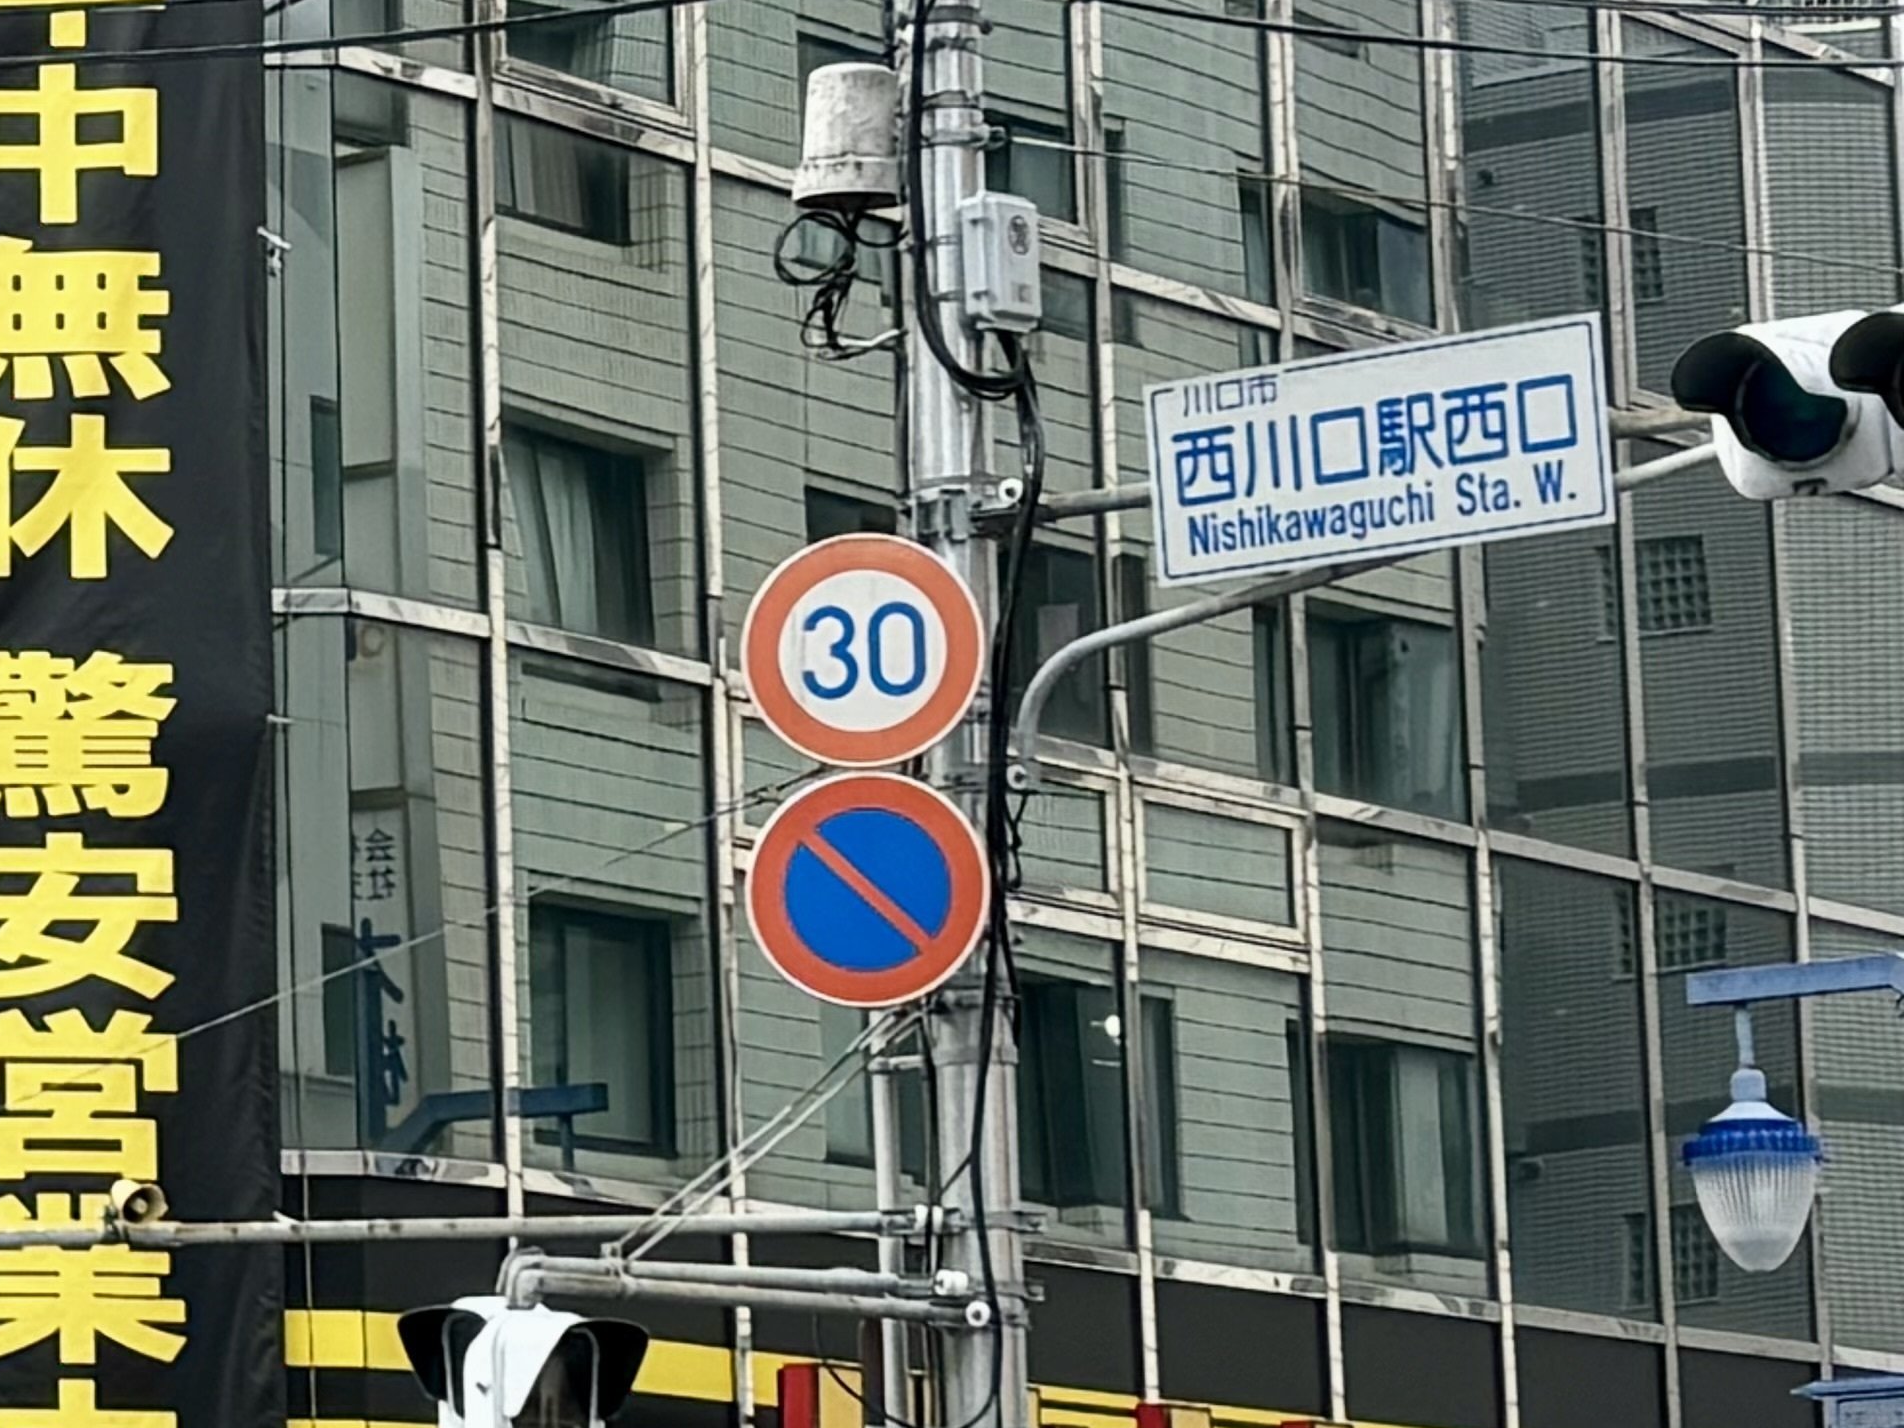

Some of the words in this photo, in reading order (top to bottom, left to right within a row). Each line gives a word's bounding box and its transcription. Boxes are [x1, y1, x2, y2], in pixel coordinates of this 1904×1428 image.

[1171, 373, 1578, 507] 西川口駅西口
[1182, 375, 1279, 416] 川口市
[1187, 481, 1435, 557] Nishikawaguchi
[1456, 473, 1522, 517] Sta.
[1534, 459, 1578, 505] W.
[802, 601, 926, 700] 30
